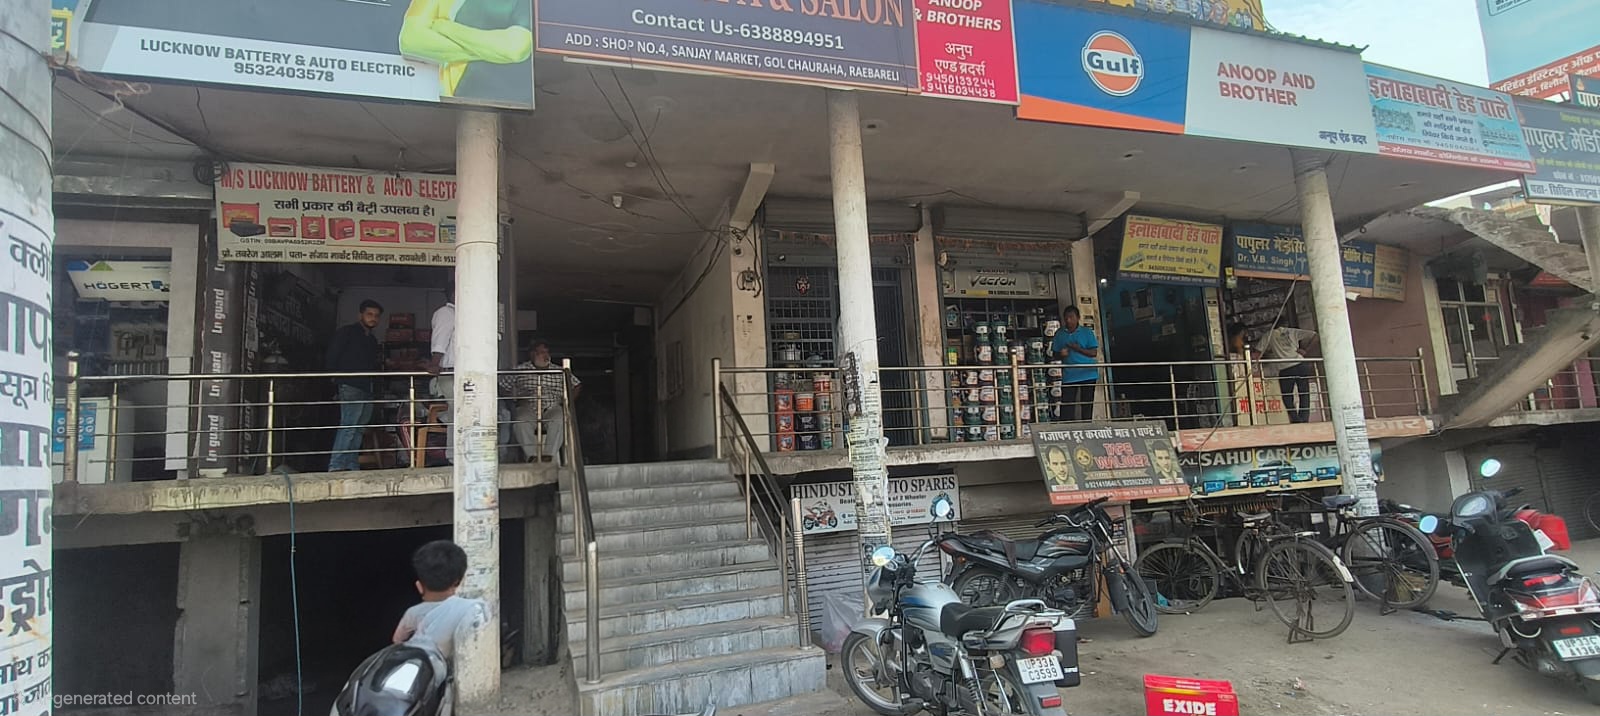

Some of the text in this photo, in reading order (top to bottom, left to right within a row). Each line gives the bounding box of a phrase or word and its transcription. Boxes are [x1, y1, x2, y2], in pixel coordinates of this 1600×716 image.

[631, 9, 844, 50] Contact Us-6388894951
[927, 10, 1002, 31] BROTHERS
[141, 38, 416, 78] LUCKNOW BATTERY & AUTO ELECTRIC
[565, 32, 592, 47] ADD
[602, 37, 634, 51] SHOP
[637, 42, 669, 57] NO.4,
[671, 44, 712, 61] SANJAY
[714, 50, 762, 69] MARKET,
[764, 55, 786, 70] GOL
[787, 57, 847, 77] CHAURAHA,
[849, 65, 900, 82] RAEBARELI
[1087, 51, 1141, 75] Gulf
[233, 62, 335, 82] 9532403578
[926, 72, 996, 89] 9450133244
[1217, 61, 1316, 90] ANOOP AND
[926, 82, 997, 98] 9415034438
[1218, 80, 1298, 106] BROTHER
[1366, 73, 1513, 120] इलाहाबादी हेड वाले
[221, 168, 244, 190] M/S
[248, 169, 308, 191] LUCKNOW
[312, 172, 363, 193] BATTERY
[366, 175, 376, 194] &
[383, 177, 413, 197] AUTO
[274, 197, 299, 210] सभी
[302, 200, 334, 212] प्रकार
[337, 200, 354, 213] की
[1128, 221, 1186, 241] इलाहाबादी
[1235, 235, 1271, 254] पापुलर
[1237, 252, 1249, 263] Dr.
[1271, 255, 1294, 267] Singh
[1200, 451, 1251, 467] SAHU
[1255, 449, 1288, 464] CAR
[1291, 444, 1338, 460] ZONE
[791, 480, 856, 499] HINDUST
[910, 476, 955, 493] SPARES
[1024, 656, 1055, 670] UP33A
[1028, 667, 1058, 681] C3599
[1163, 698, 1217, 716] EXIDE
